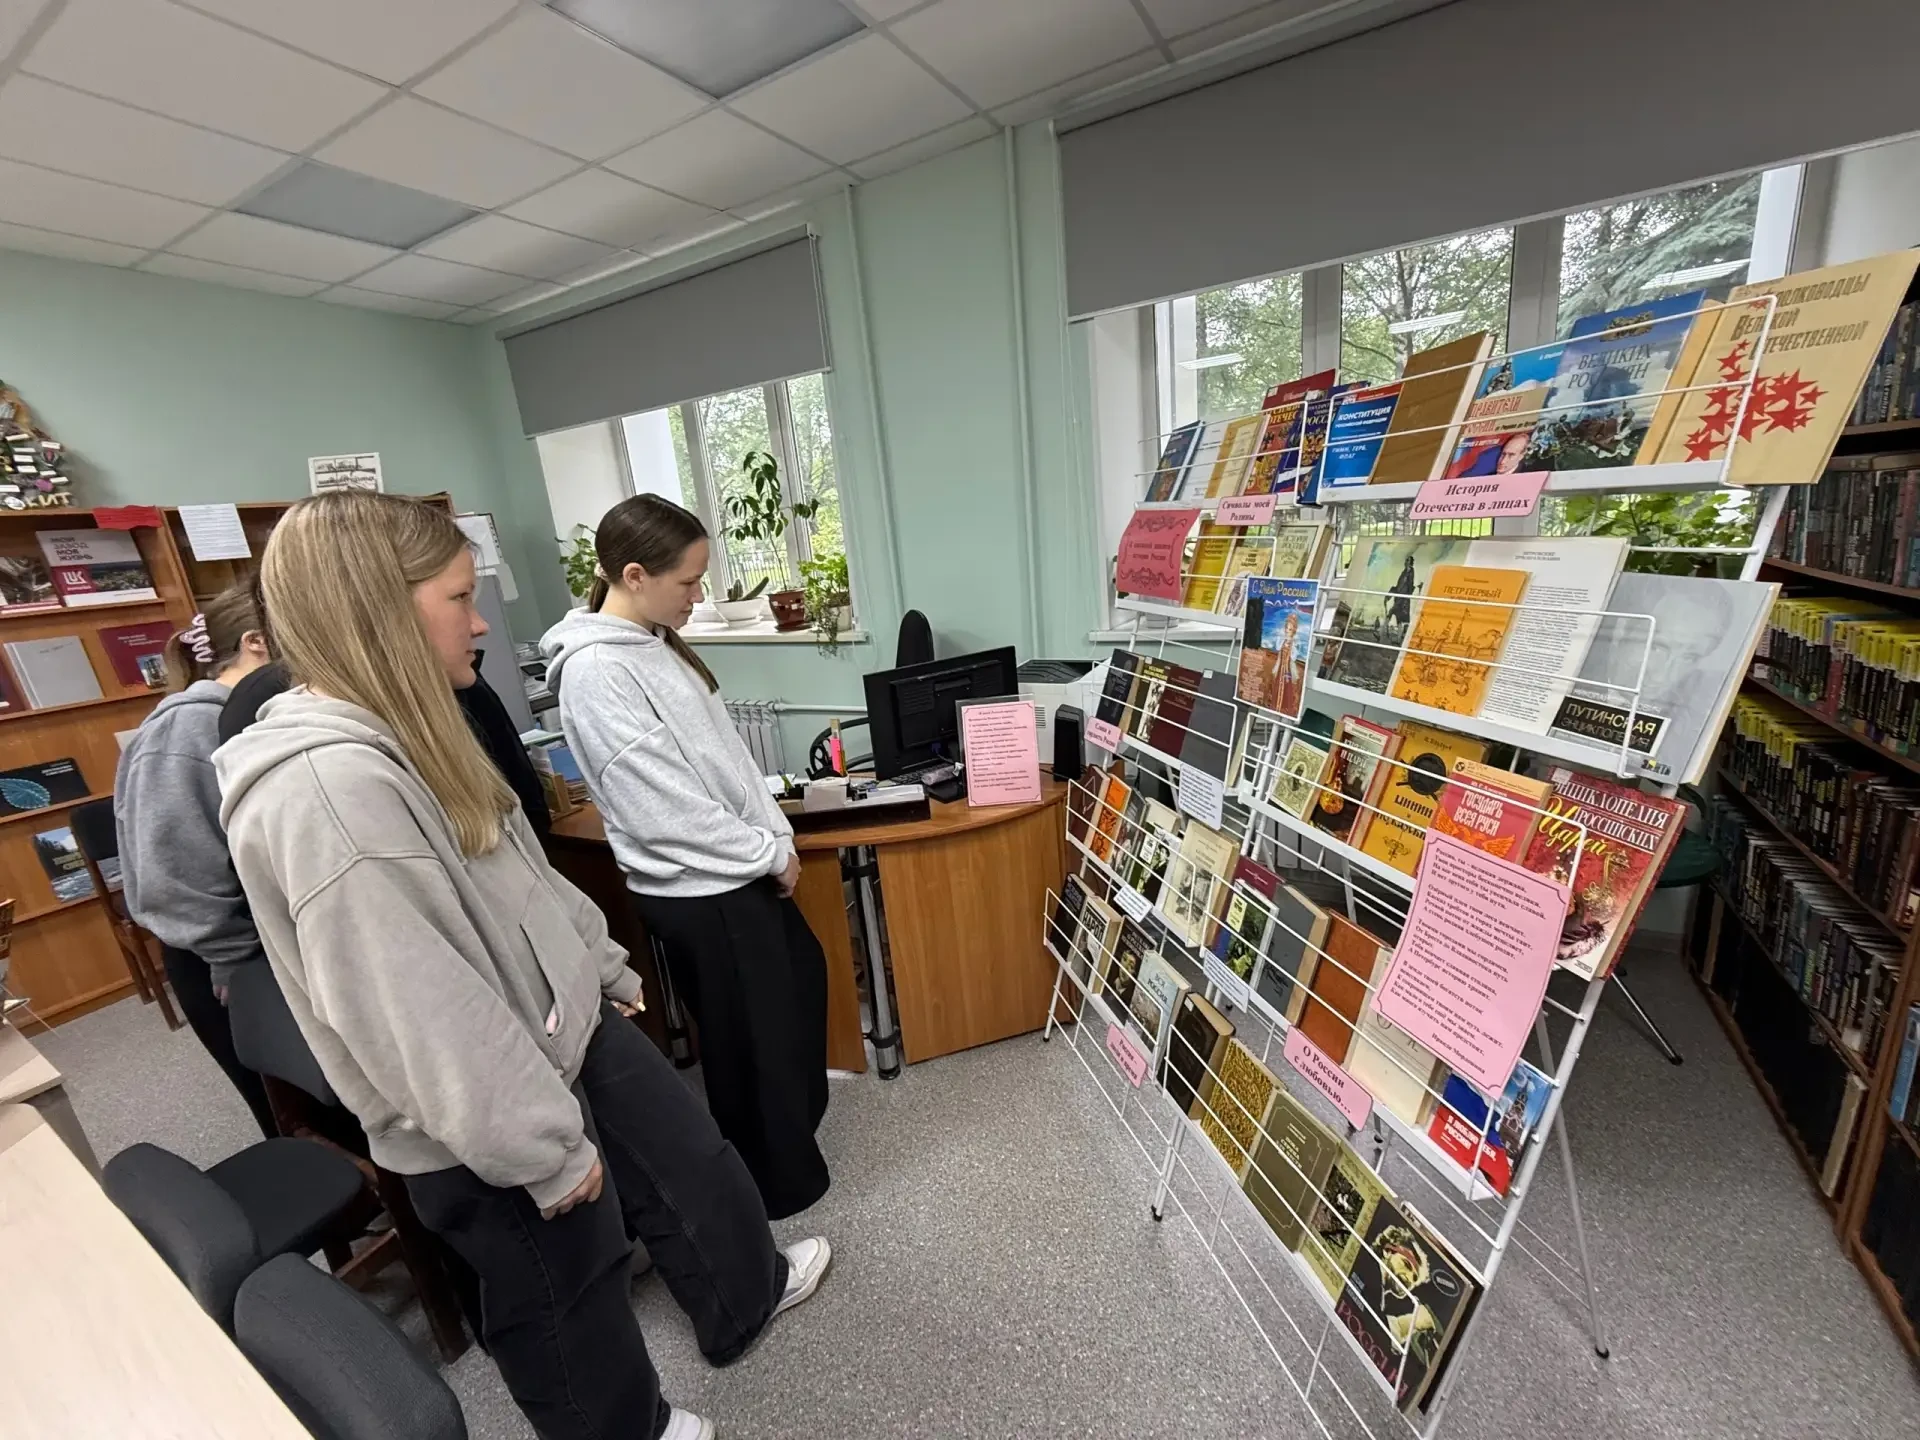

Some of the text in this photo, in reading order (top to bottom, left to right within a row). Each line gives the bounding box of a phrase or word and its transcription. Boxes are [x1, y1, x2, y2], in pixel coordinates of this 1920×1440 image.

[1731, 308, 1800, 341] ВЕЛКОЙ
[1337, 405, 1392, 421] КОНСТИТУЦИЯ
[1222, 500, 1251, 509] Символы
[1445, 483, 1500, 497] История
[1414, 498, 1531, 514] Отечества в лицах
[1561, 717, 1651, 747] ЭНЦИКЛОПЕИЯ
[1461, 790, 1504, 819] ГОСУДАРЬ
[1553, 781, 1670, 829] ЭНЦИКЛОПЕДИЯ
[1453, 806, 1500, 837] ВСЕЯ РУСИ
[1573, 806, 1660, 850] РОССИЙСКИХ
[1303, 1045, 1345, 1089] О России
[1294, 1055, 1351, 1114] с любовью...
[1483, 1143, 1497, 1162] ЕБЯ,
